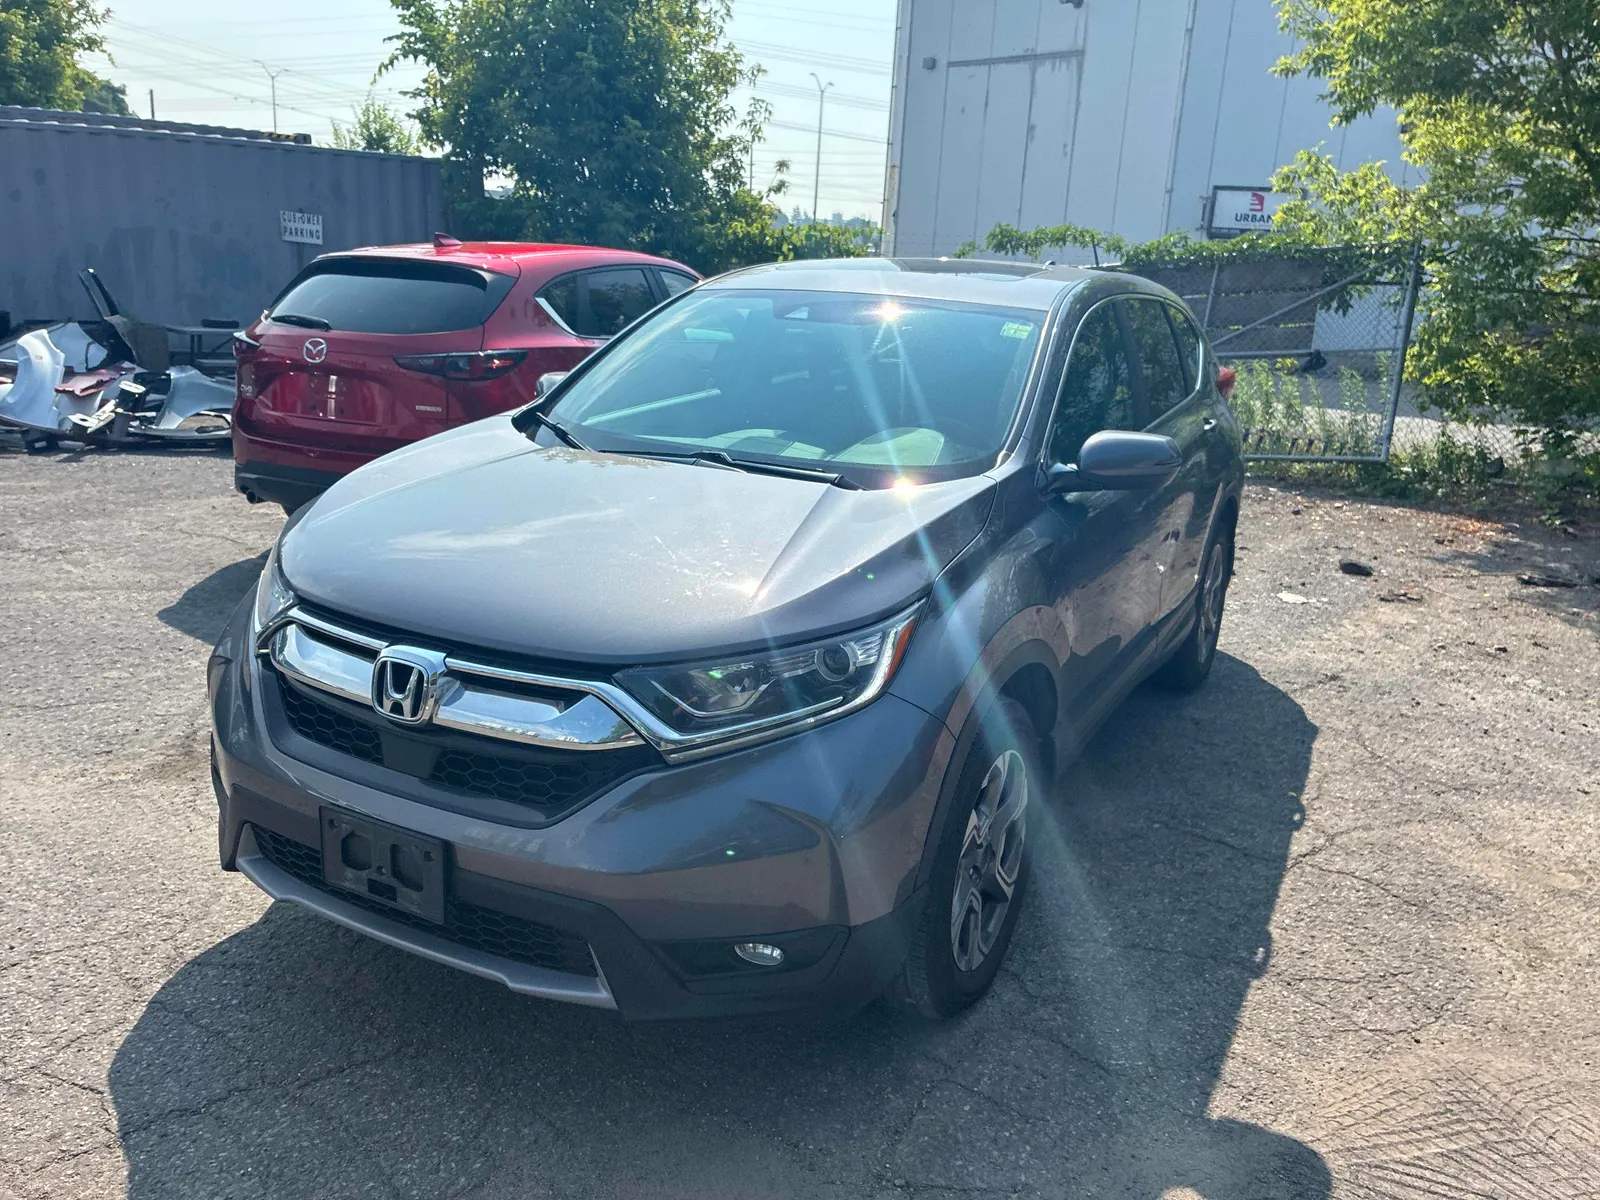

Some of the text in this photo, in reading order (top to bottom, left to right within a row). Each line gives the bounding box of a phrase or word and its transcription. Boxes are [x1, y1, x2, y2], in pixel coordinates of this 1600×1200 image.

[281, 211, 320, 225] CUSTOMER
[1234, 213, 1274, 223] URBAN
[283, 226, 321, 240] PARKING
